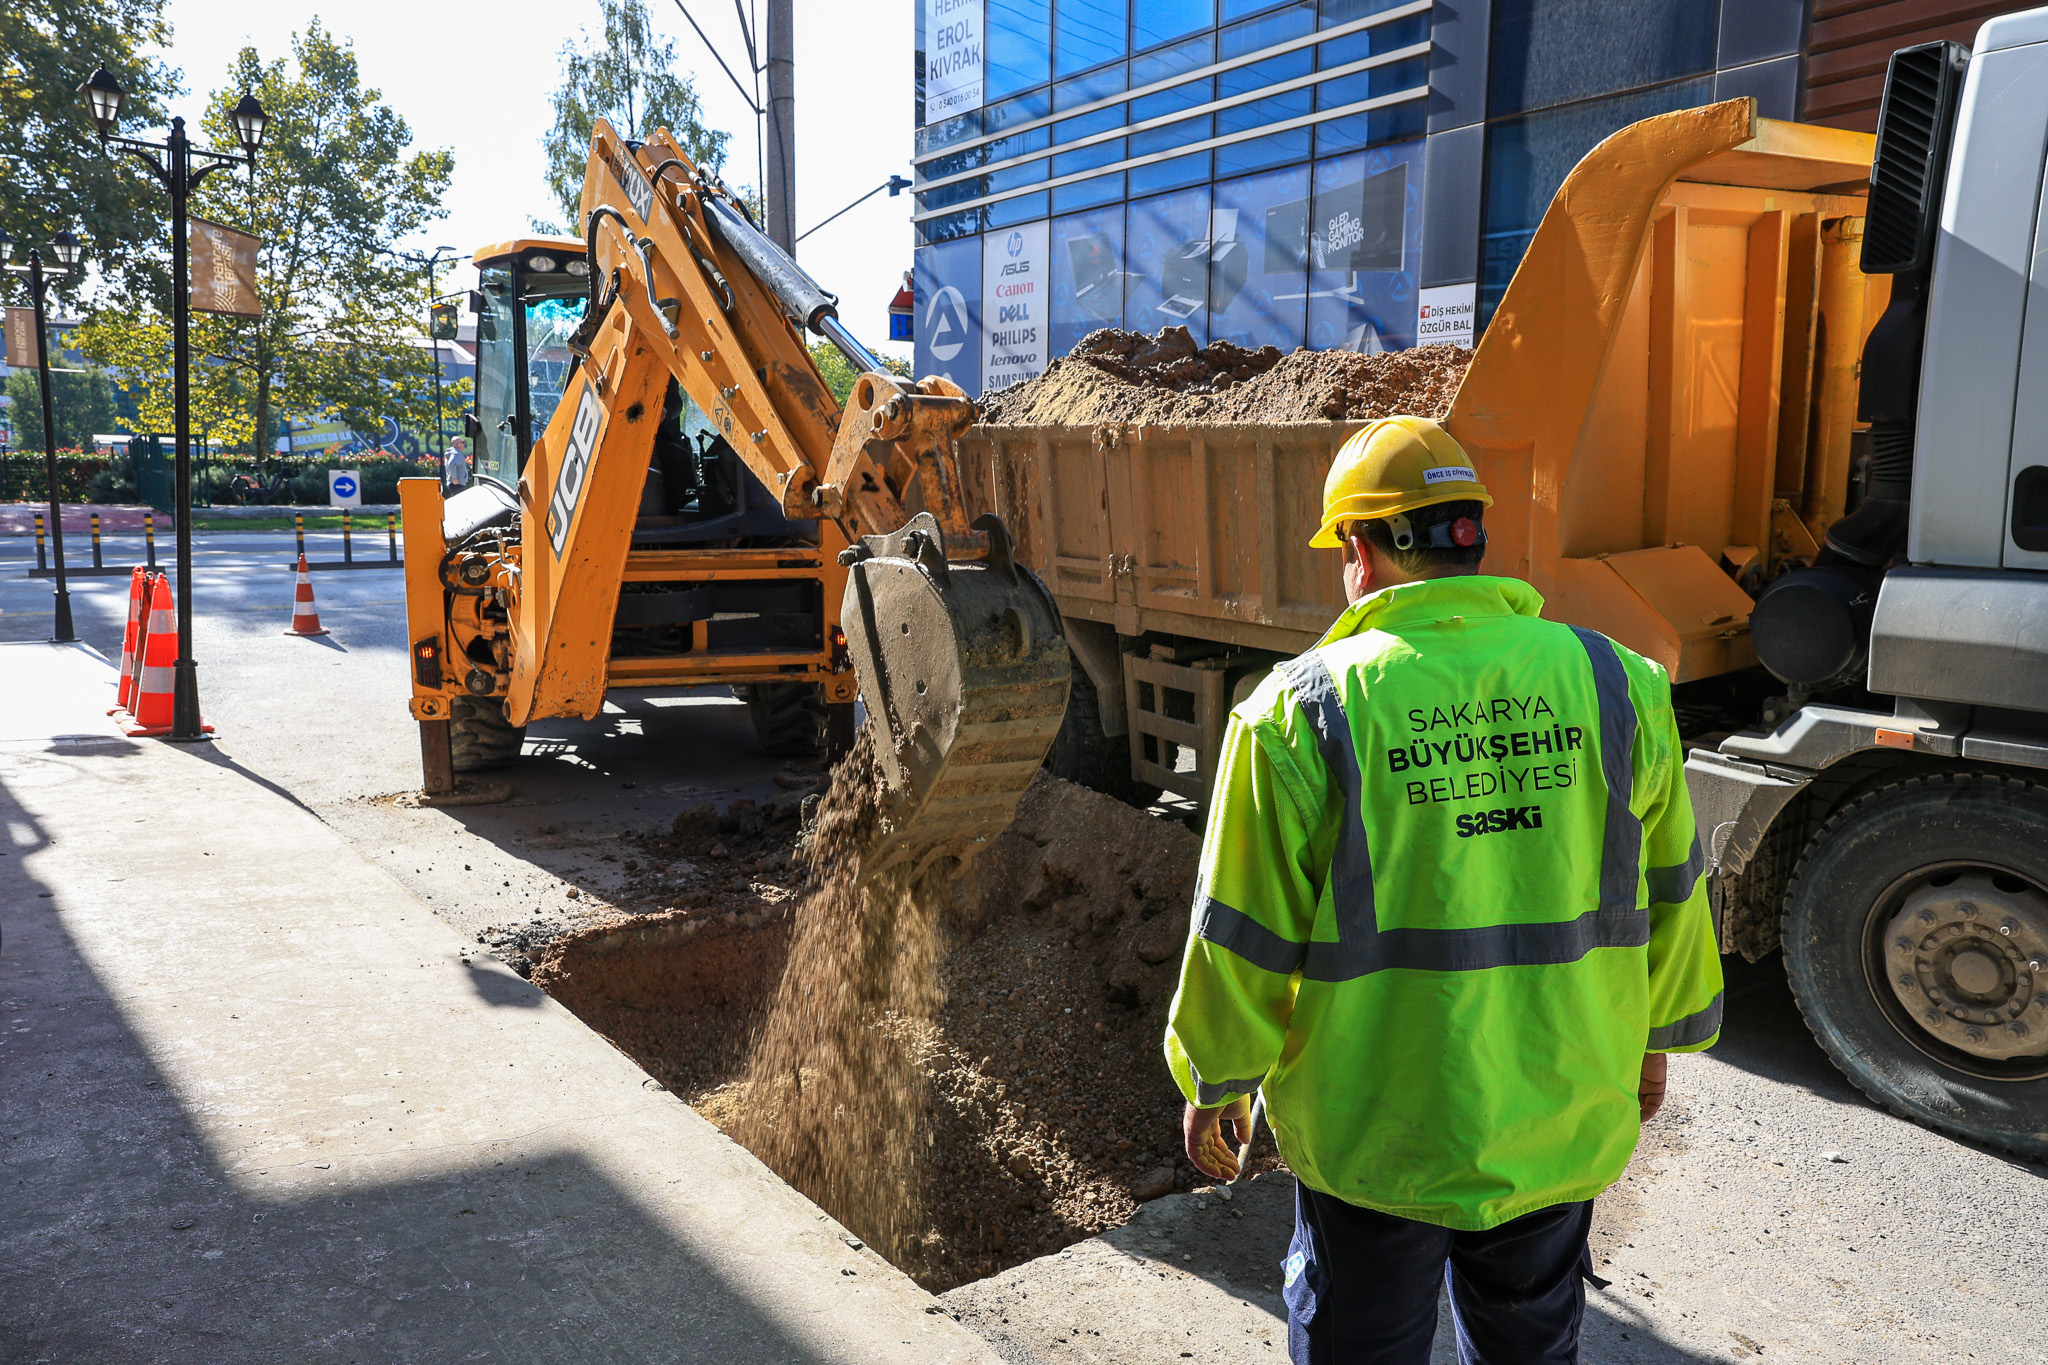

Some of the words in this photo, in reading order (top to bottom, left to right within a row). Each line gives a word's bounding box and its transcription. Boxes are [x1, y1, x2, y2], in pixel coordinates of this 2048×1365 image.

[937, 18, 974, 51] EROL
[930, 42, 981, 81] KIVRAK
[1328, 211, 1349, 231] QLED
[1328, 217, 1360, 242] GAMING
[1008, 232, 1023, 257] hp
[1327, 227, 1364, 254] MONITOR
[1001, 260, 1030, 277] ASUS
[996, 281, 1034, 298] Canon
[1000, 303, 1029, 324] DELL
[1431, 305, 1444, 318] DİŞ
[1446, 301, 1474, 315] HEKİMİ
[1420, 320, 1451, 334] ÖZGÜR
[1453, 320, 1471, 331] BAL
[990, 353, 1037, 367] lenovo
[553, 390, 599, 553] JCB
[1408, 695, 1555, 732] SAKARYA
[1387, 723, 1583, 773] BÜYÜKŞEHİR
[1406, 757, 1577, 805] BELEDİYESİ
